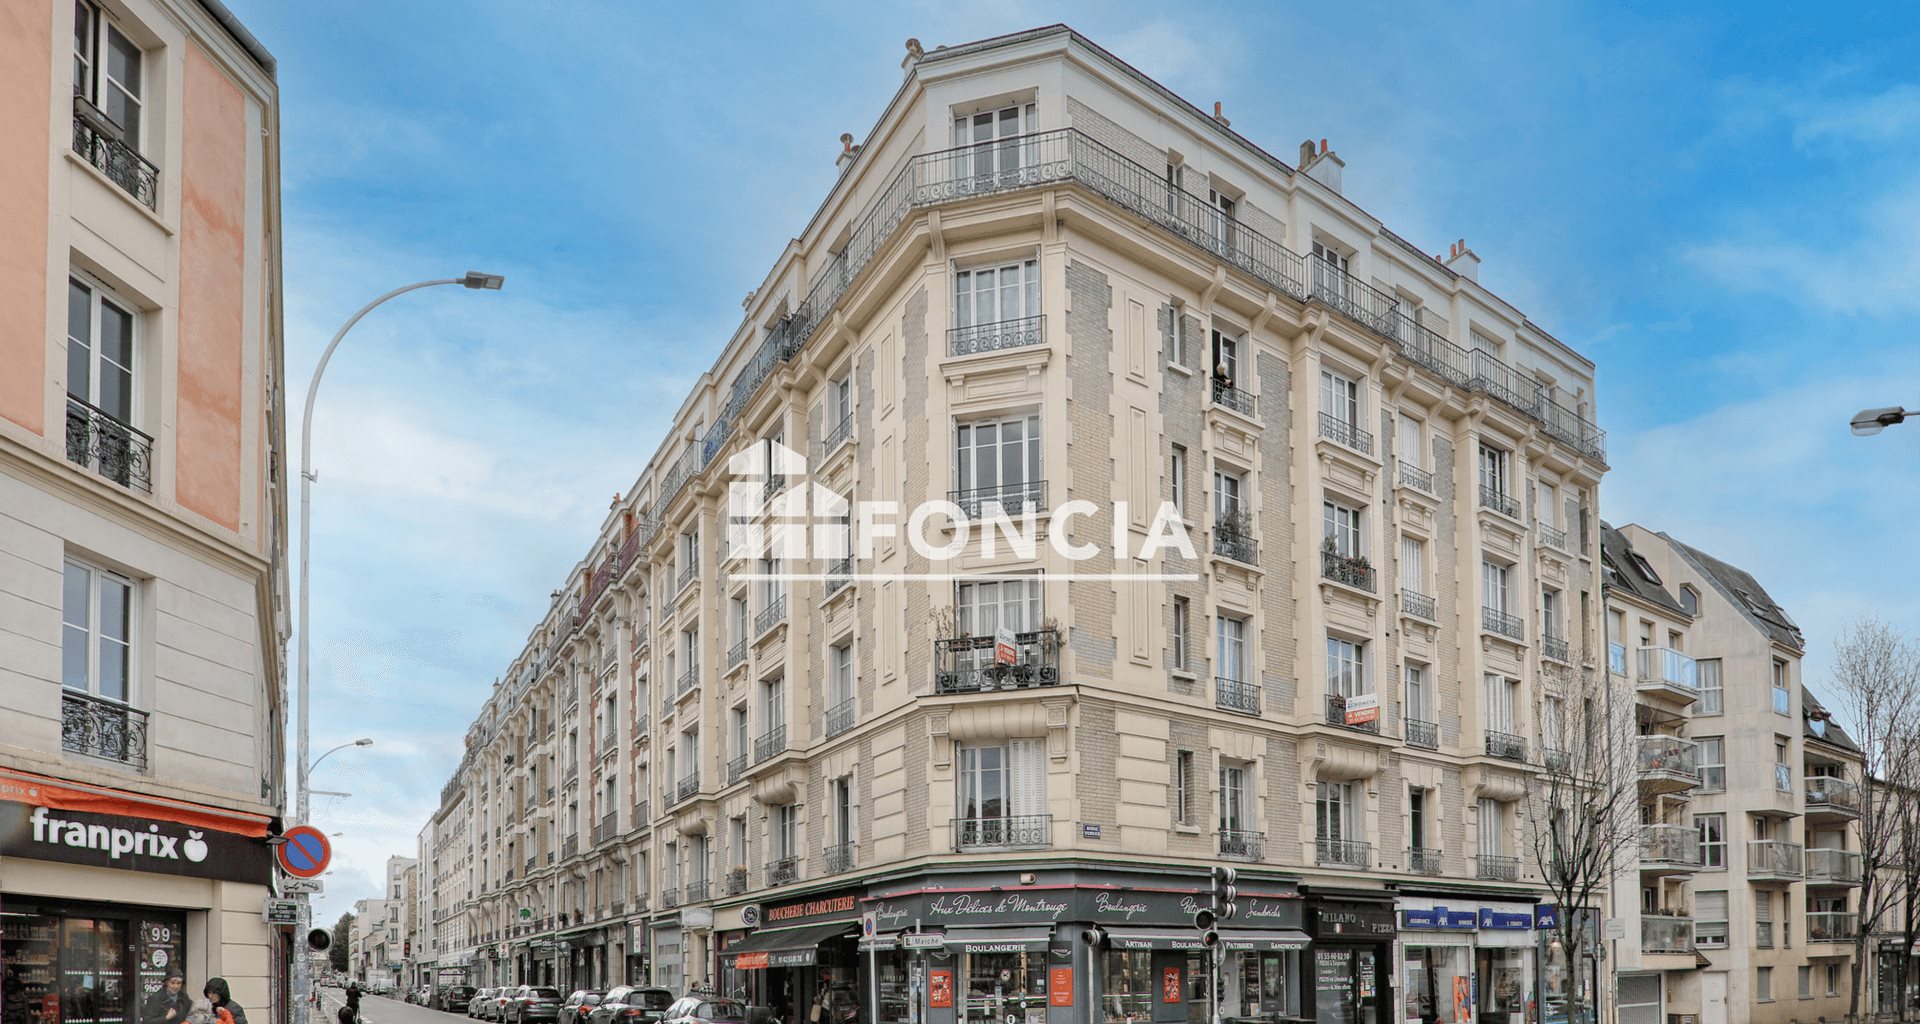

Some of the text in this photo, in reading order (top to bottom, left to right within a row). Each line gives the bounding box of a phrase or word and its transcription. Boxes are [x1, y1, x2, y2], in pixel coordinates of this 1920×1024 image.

[29, 807, 179, 859] franprix
[768, 896, 855, 921] BOUCHERIE CHARCUTERIE
[929, 896, 953, 915] Aux
[995, 899, 1008, 913] de
[1008, 894, 1068, 919] Montrouge
[1095, 892, 1148, 920] Boulangerie
[1322, 912, 1356, 923] MILANO
[1372, 923, 1395, 934] PIZZA
[1537, 915, 1555, 926] AXA
[151, 927, 170, 942] 99
[915, 936, 939, 945] Marché
[965, 944, 1027, 953] BOULANGERIE
[1124, 940, 1153, 948] ARTISAN
[1171, 941, 1208, 949] BOULANGE
